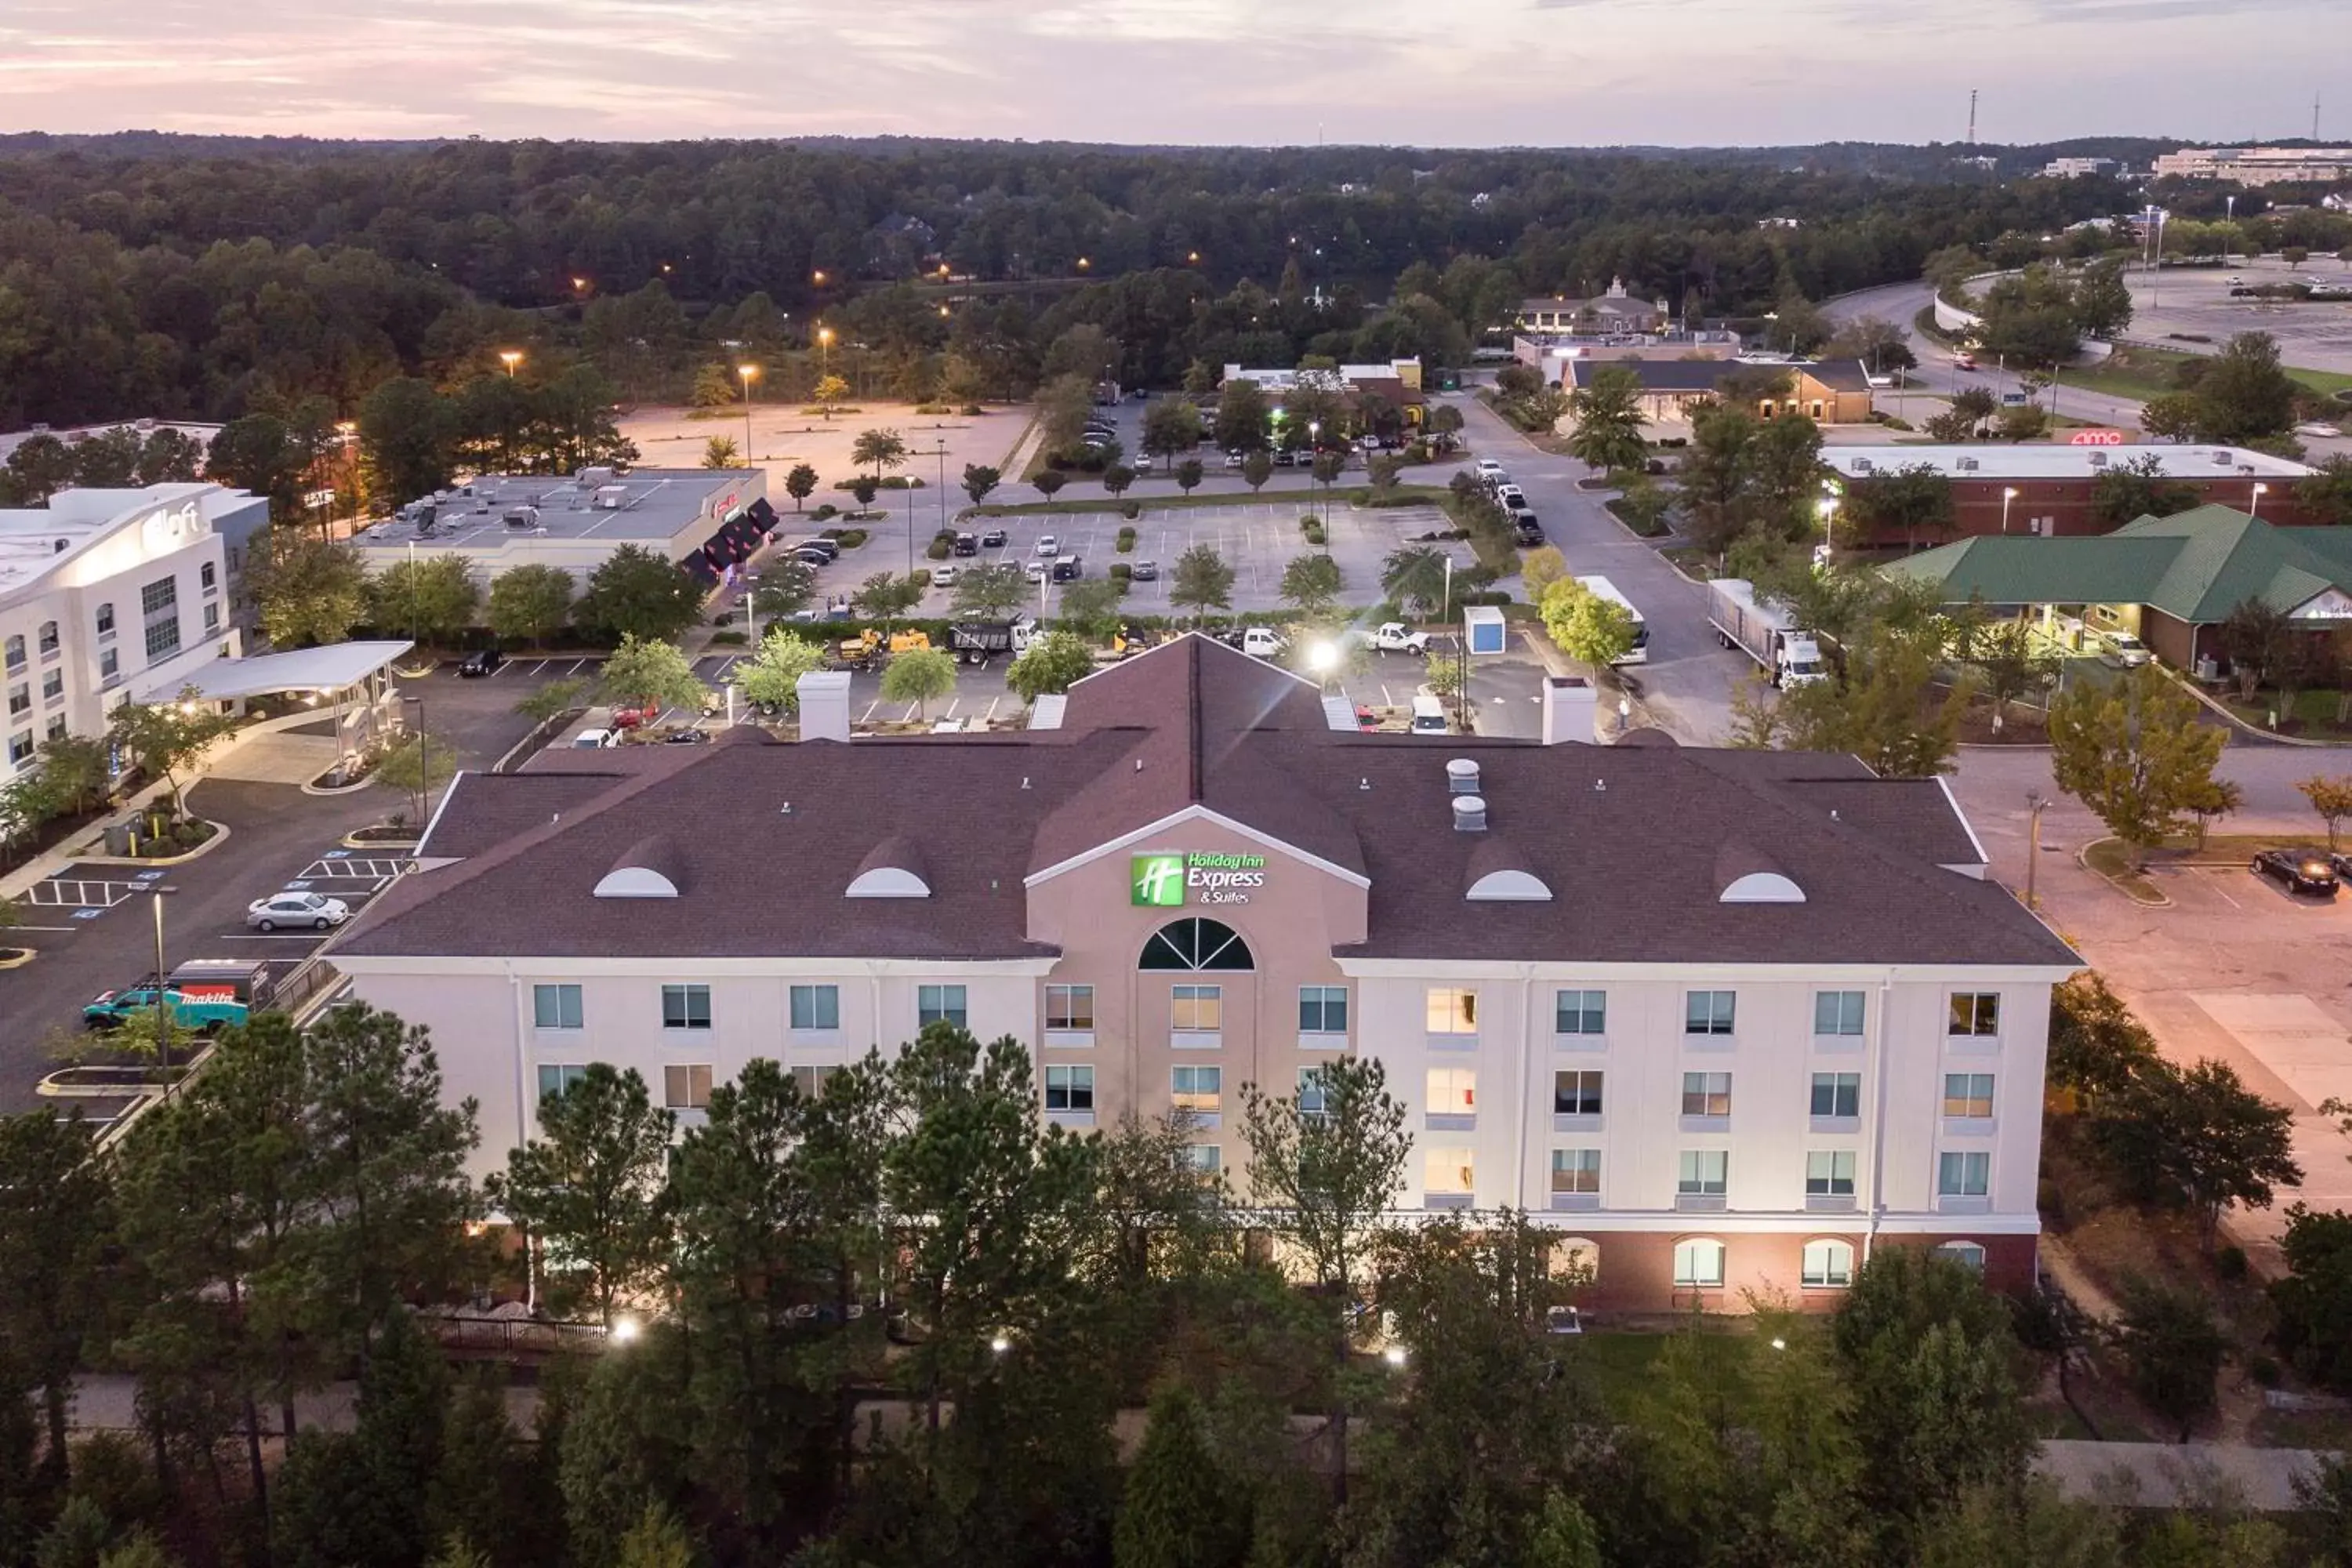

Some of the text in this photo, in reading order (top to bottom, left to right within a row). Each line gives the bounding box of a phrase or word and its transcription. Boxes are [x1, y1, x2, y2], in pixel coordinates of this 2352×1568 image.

[1189, 852, 1240, 869] Holiday
[1188, 867, 1264, 891] Express
[1200, 891, 1249, 904] & Suites
